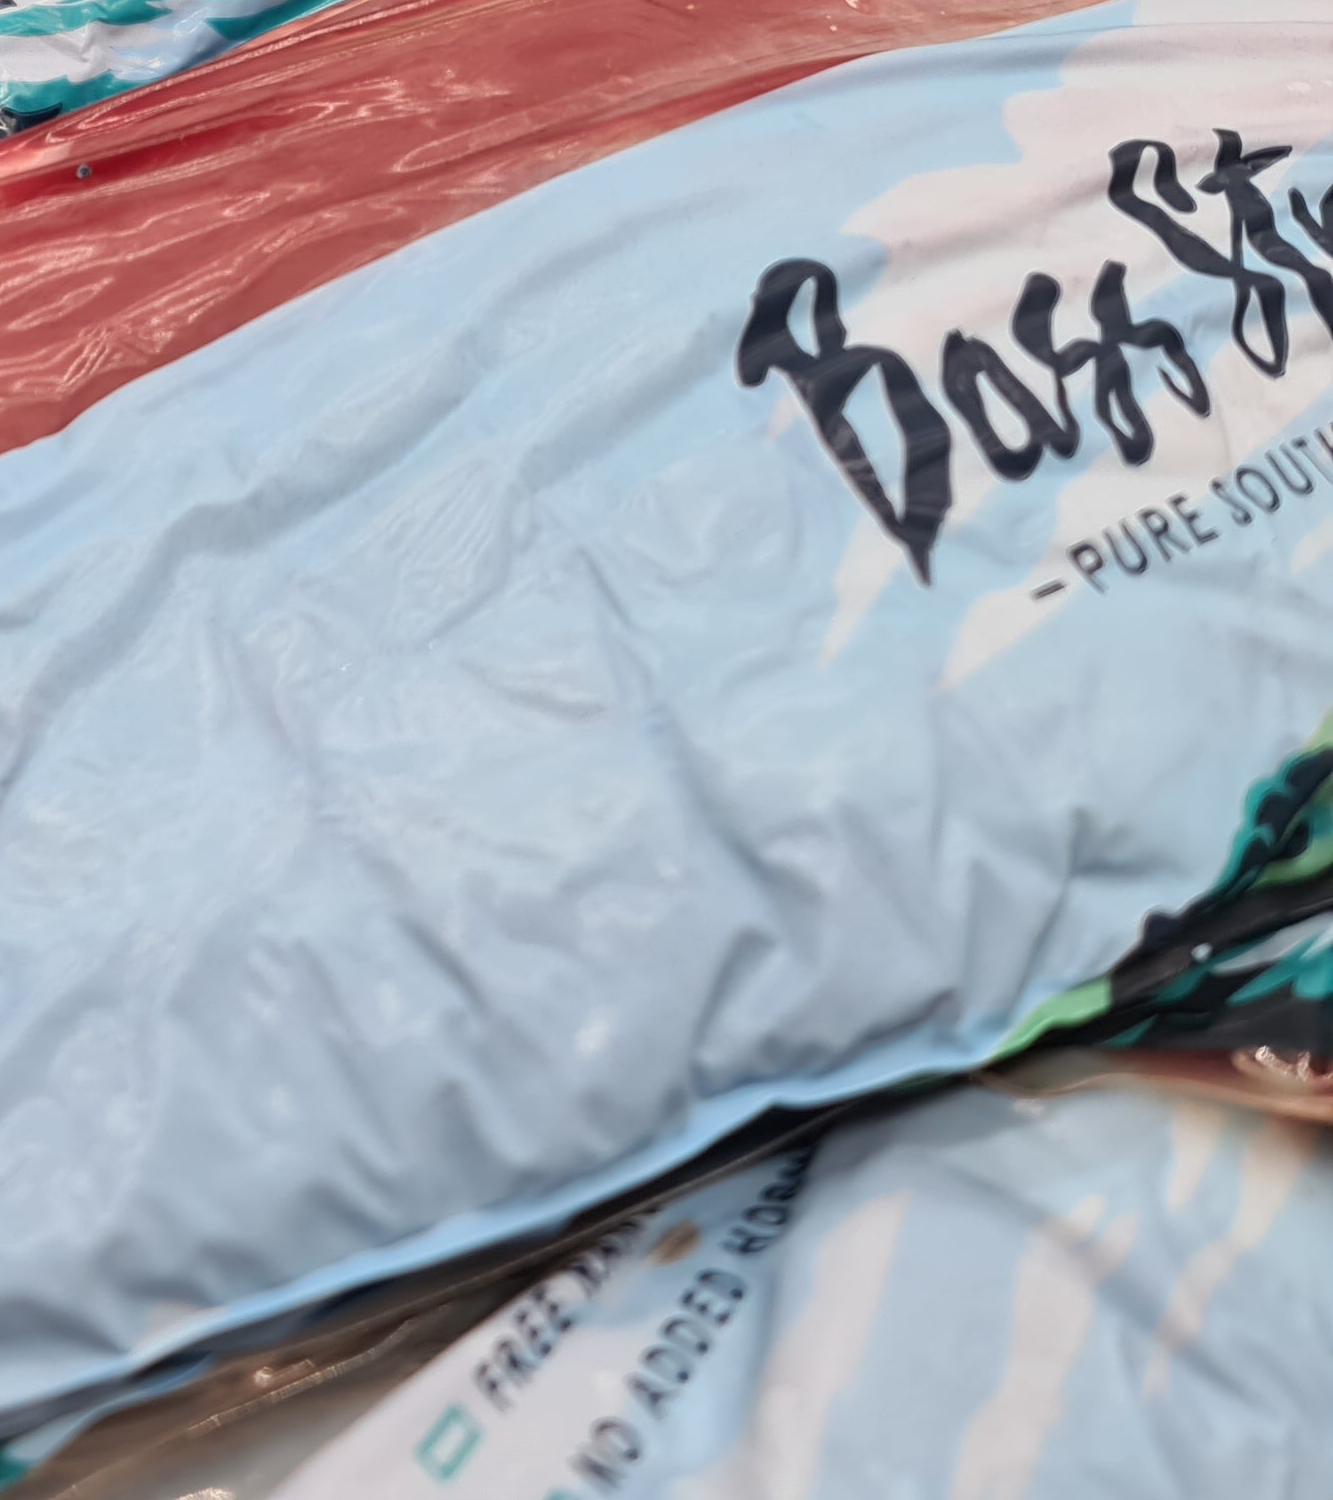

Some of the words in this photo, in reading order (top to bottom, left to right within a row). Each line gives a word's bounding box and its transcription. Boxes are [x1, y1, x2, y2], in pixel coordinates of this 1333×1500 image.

[737, 257, 1210, 589] Bass
[570, 1417, 642, 1493] NO
[627, 1268, 747, 1418] ADDED
